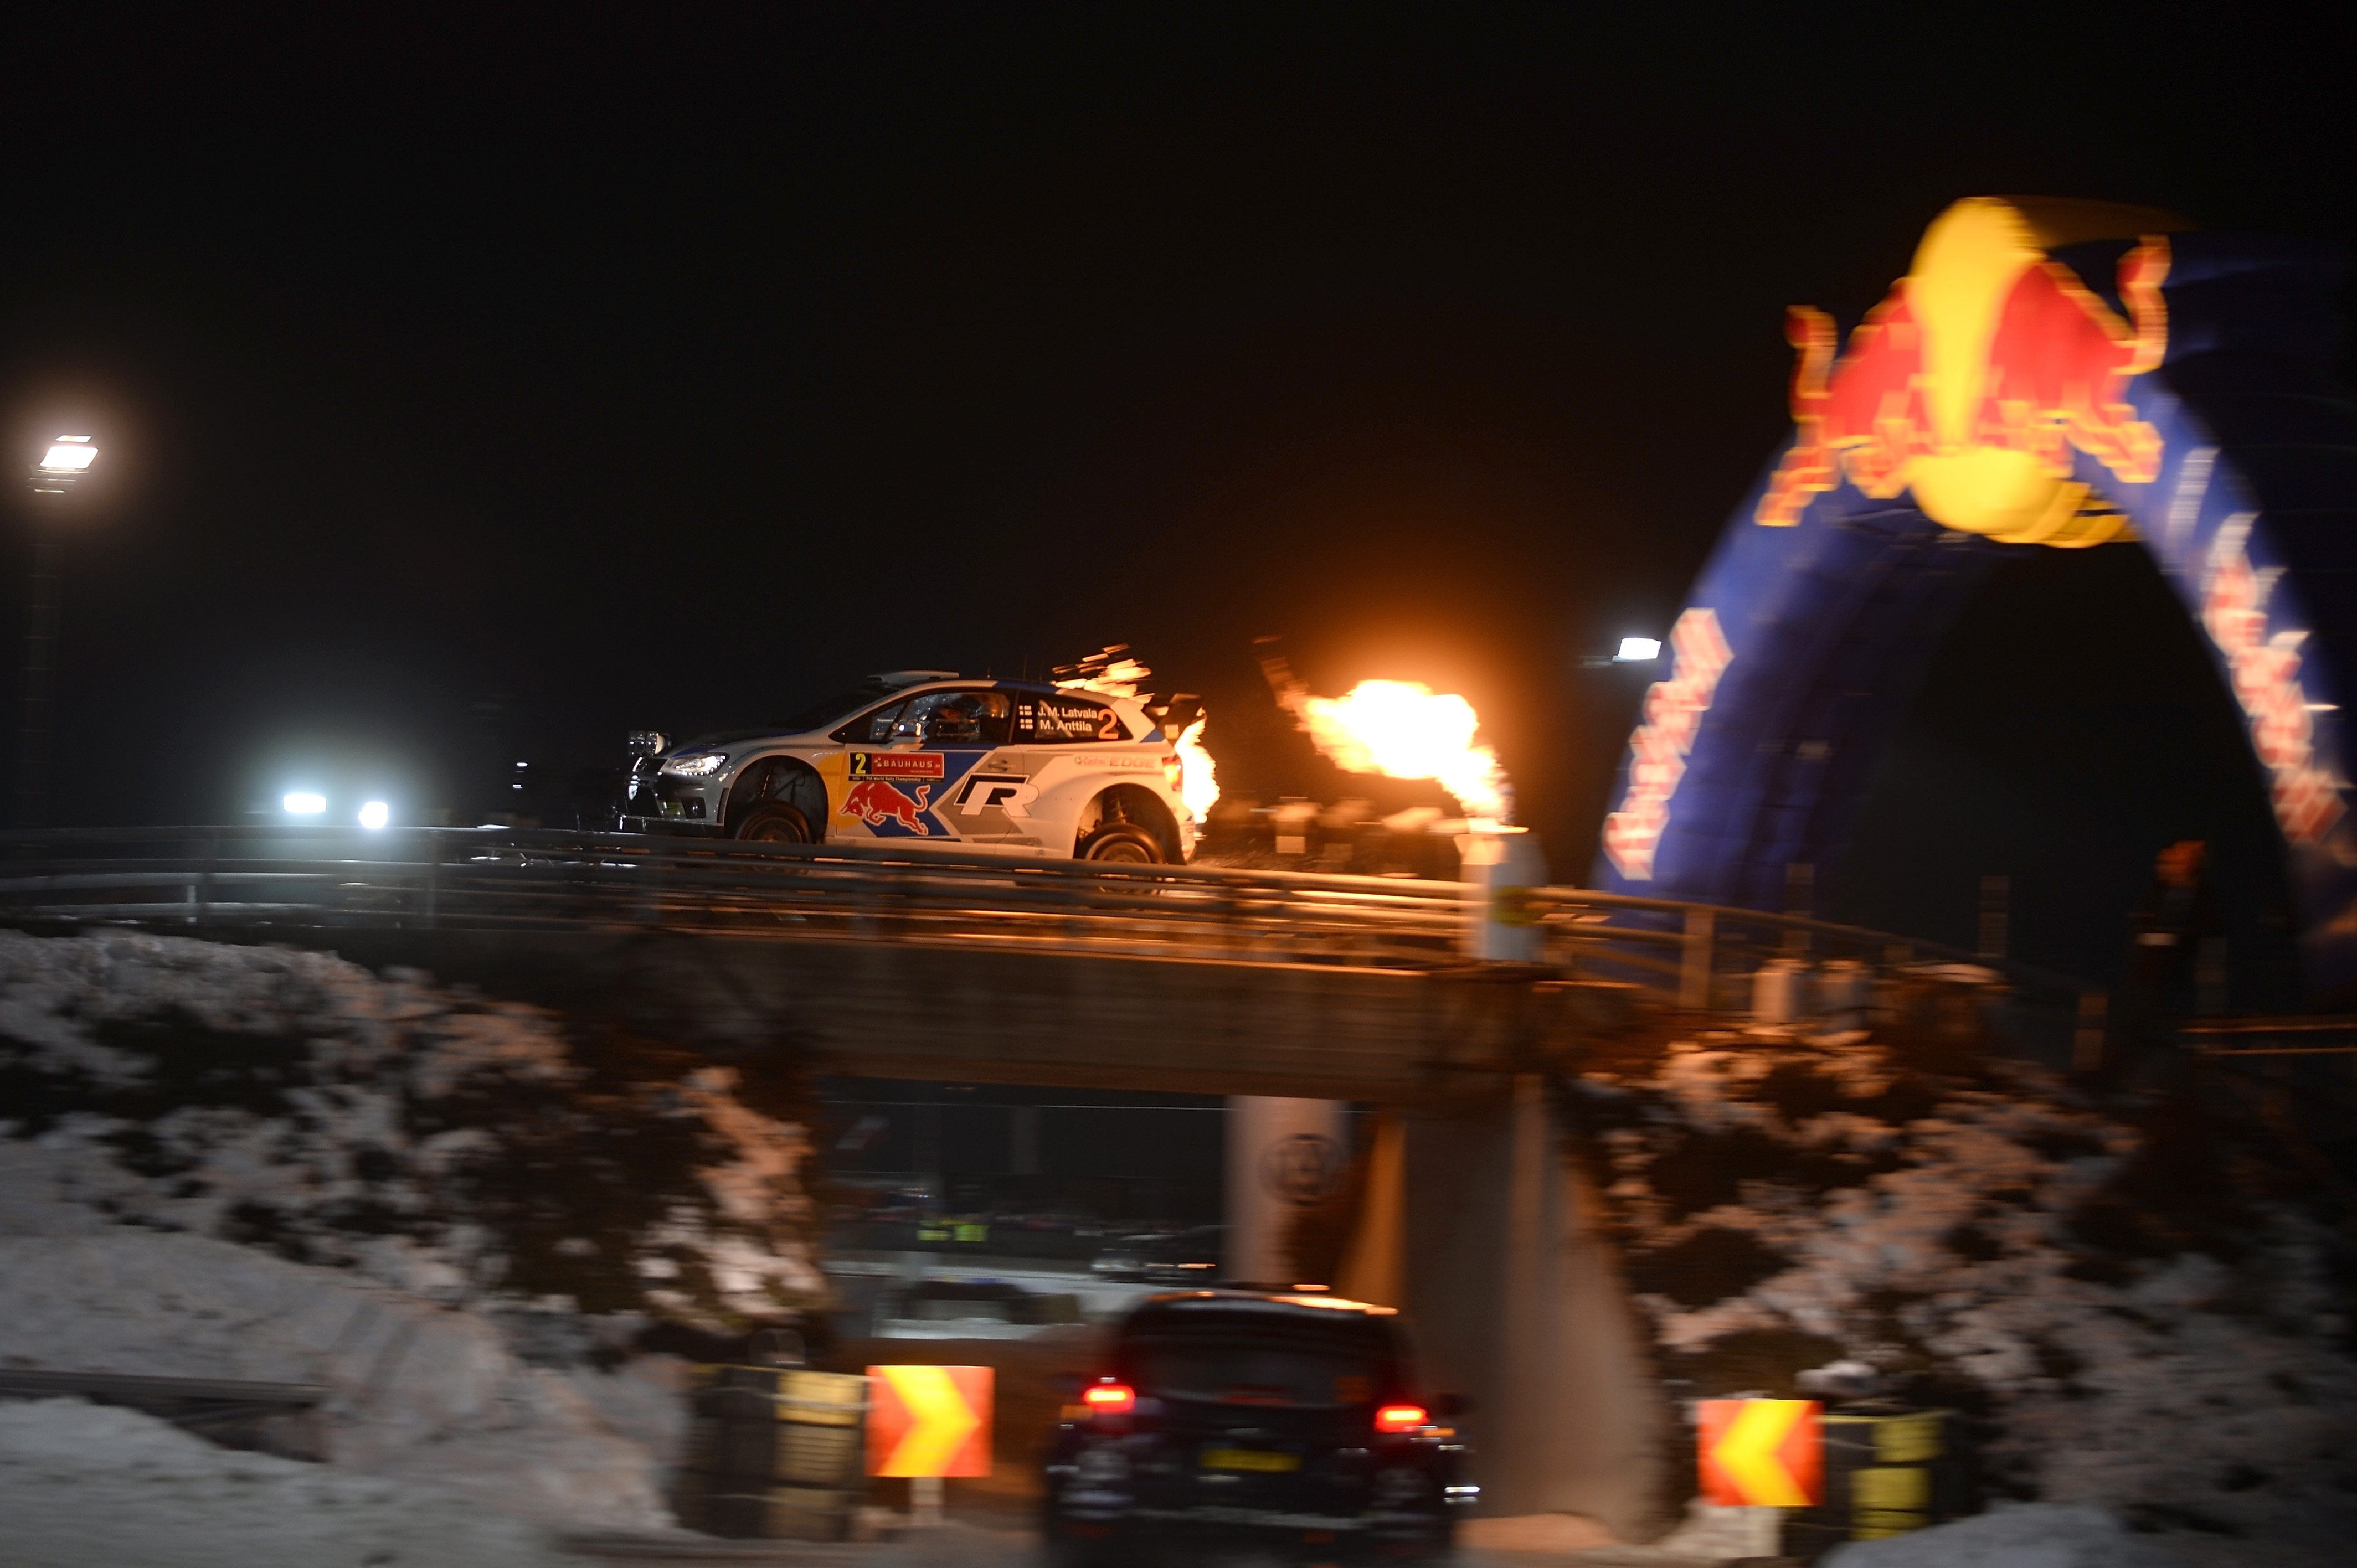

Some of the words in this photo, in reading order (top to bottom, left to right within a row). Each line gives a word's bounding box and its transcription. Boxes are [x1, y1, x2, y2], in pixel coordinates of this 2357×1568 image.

[1062, 707, 1098, 719] Latvala
[1039, 720, 1054, 730] M.
[1057, 720, 1092, 732] Anttila
[1098, 708, 1119, 739] 2
[855, 753, 866, 775] 2
[1083, 756, 1106, 766] Castrol
[1109, 757, 1156, 768] EDGE
[960, 781, 1040, 817] R
